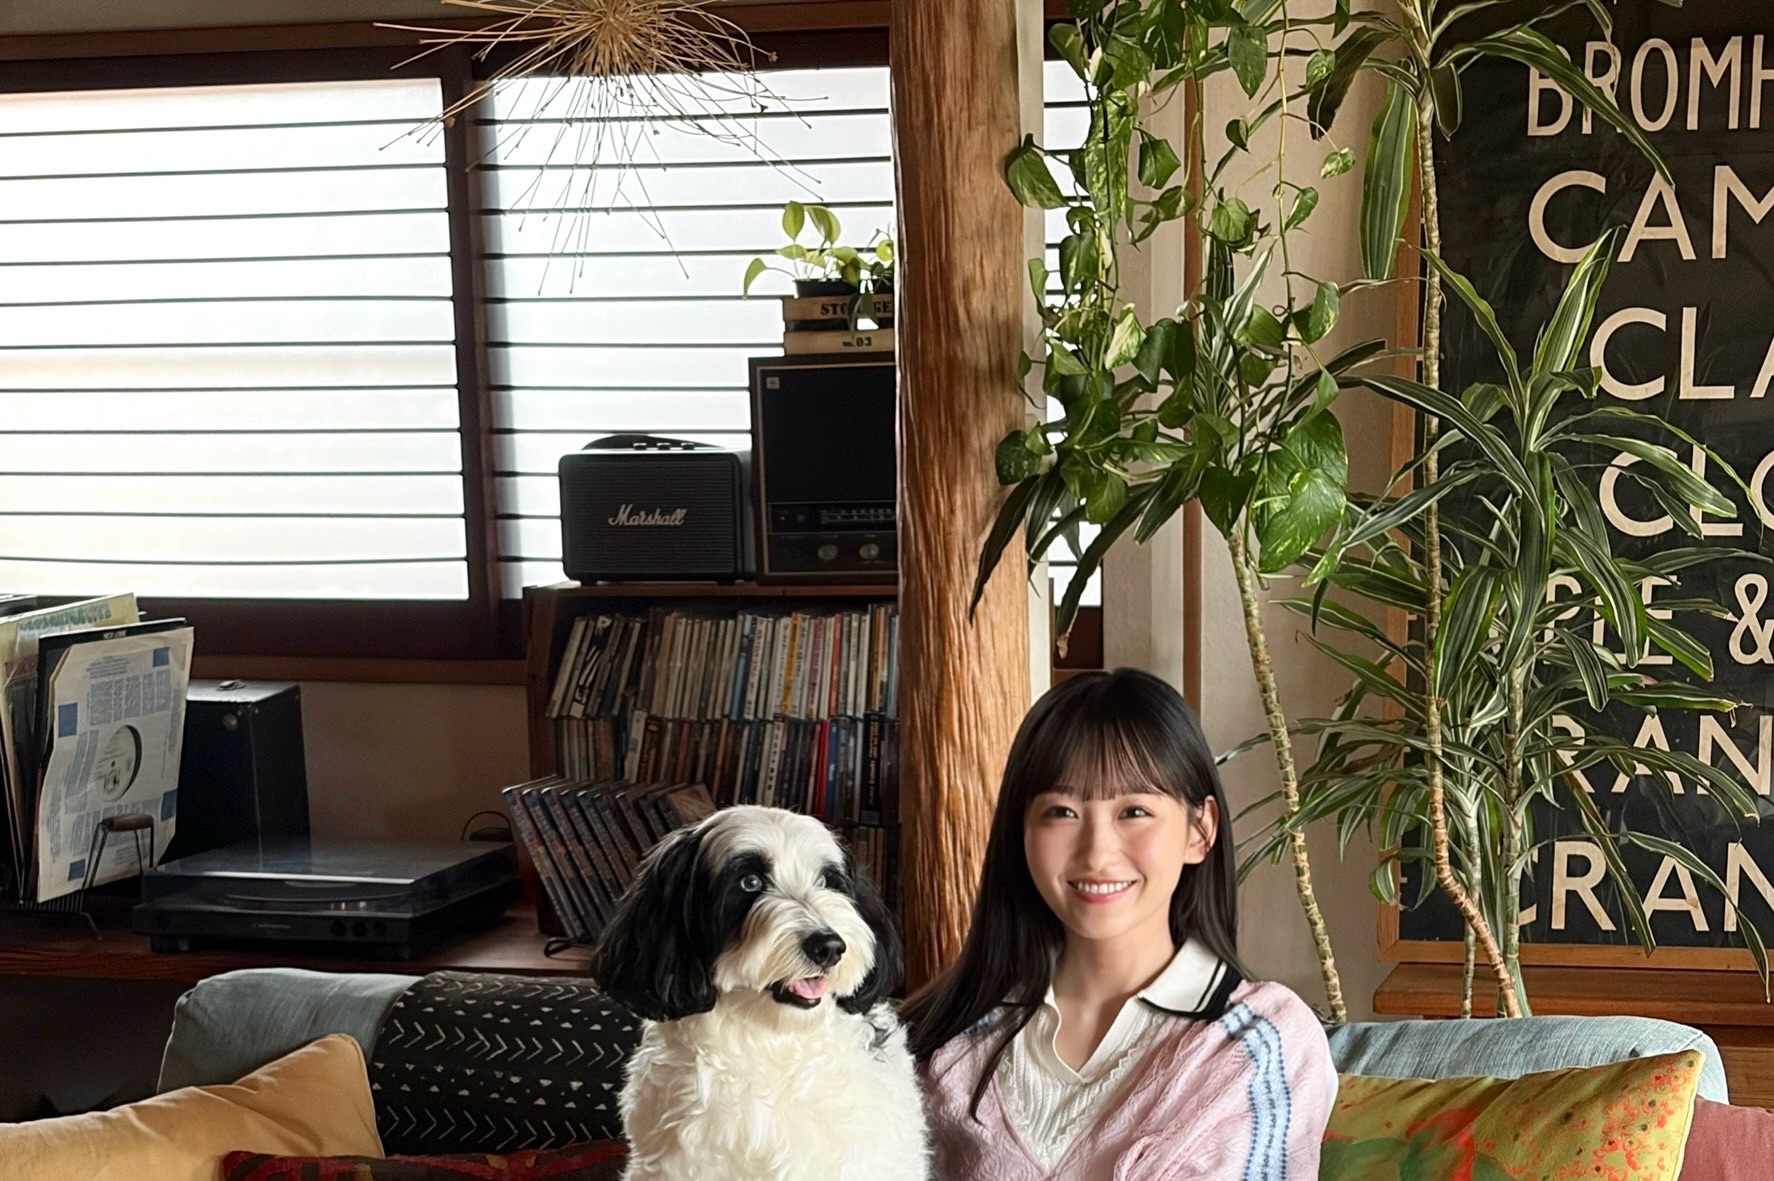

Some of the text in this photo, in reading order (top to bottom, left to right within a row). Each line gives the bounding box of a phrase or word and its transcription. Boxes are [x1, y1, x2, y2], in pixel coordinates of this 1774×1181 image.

[1527, 34, 1774, 136] BROMH
[1528, 165, 1774, 263] CAM
[608, 503, 687, 526] Marshall
[1599, 443, 1774, 537] CL
[1728, 573, 1774, 665] &
[1537, 714, 1774, 796] RAN
[1519, 840, 1774, 932] RAN
